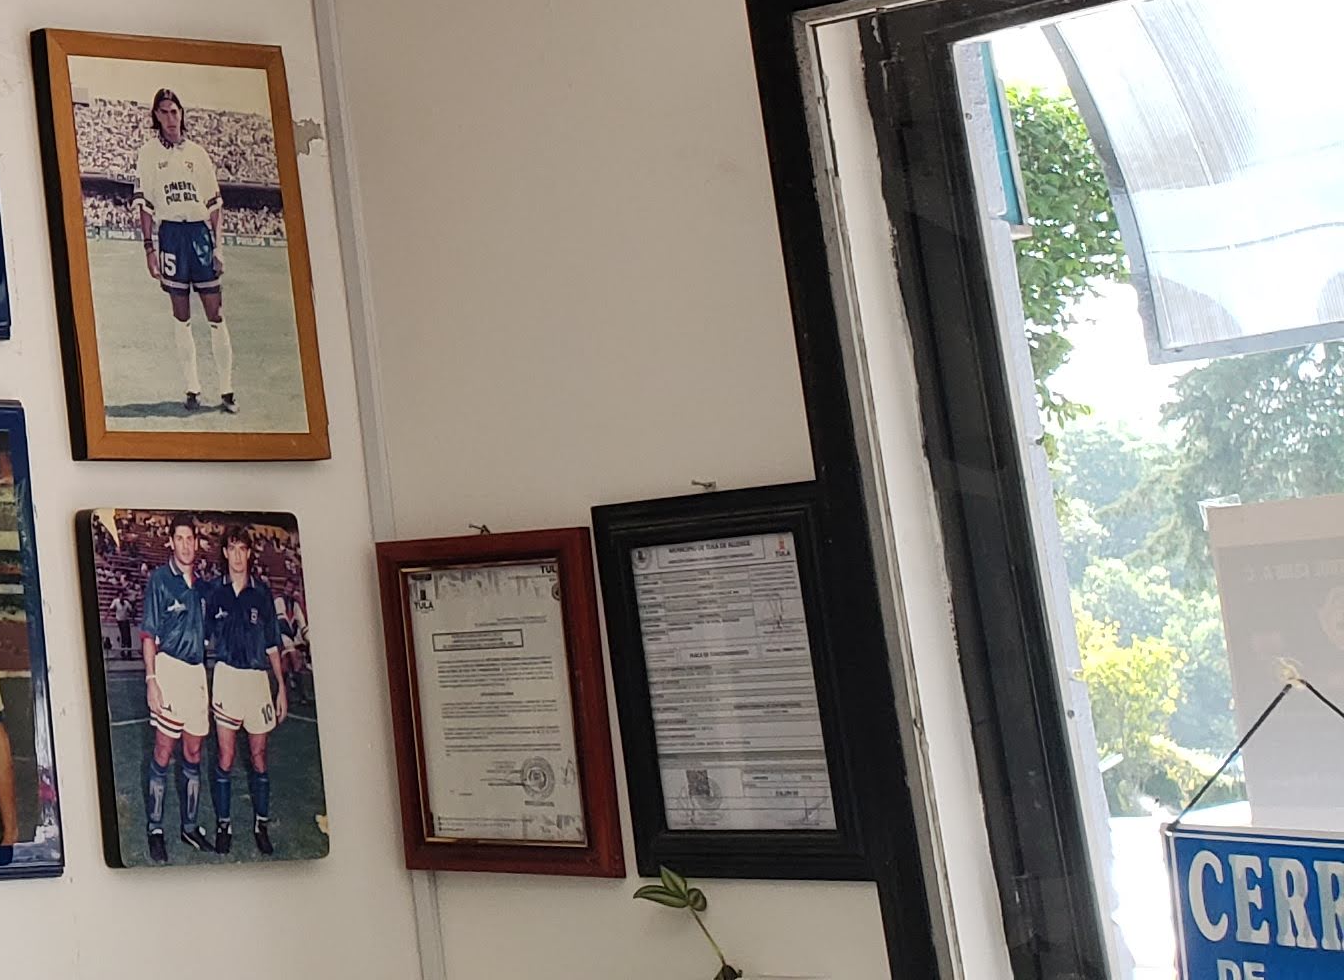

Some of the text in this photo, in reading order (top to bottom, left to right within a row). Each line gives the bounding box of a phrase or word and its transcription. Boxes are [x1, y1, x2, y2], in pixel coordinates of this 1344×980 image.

[160, 250, 177, 277] 15
[540, 565, 558, 574] TUL
[414, 601, 433, 609] TULA
[261, 703, 273, 725] 10
[1188, 850, 1344, 951] CERR
